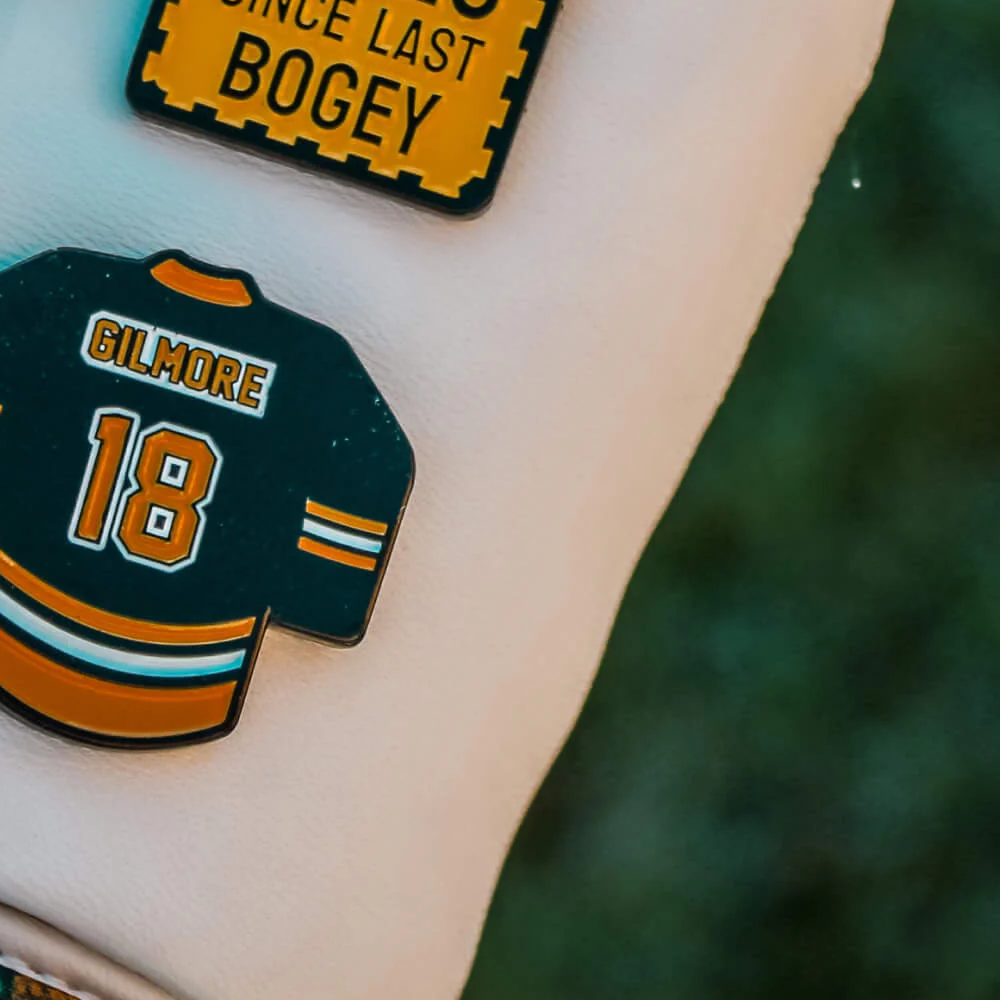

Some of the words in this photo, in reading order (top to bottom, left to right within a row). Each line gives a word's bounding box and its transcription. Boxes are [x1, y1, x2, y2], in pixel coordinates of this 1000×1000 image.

[218, 31, 444, 157] BOGEY
[367, 8, 486, 82] LAST
[87, 317, 269, 410] GILMORE
[69, 409, 222, 570] 18
